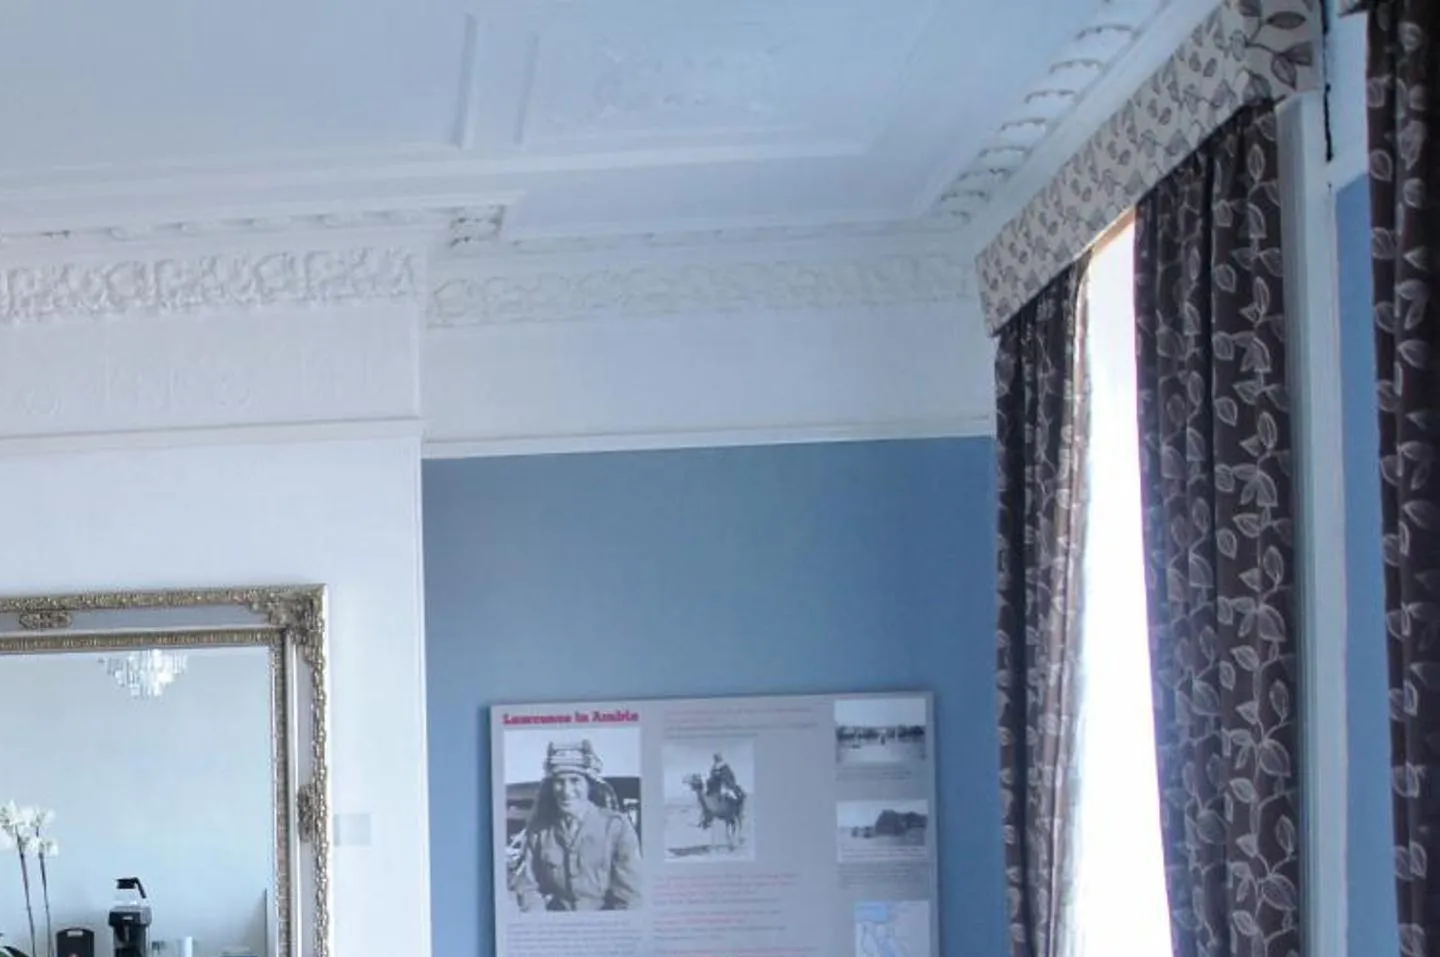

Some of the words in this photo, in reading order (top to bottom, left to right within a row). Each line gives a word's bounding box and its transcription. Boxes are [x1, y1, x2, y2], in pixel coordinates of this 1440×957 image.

[503, 712, 572, 725] Lawrence
[574, 710, 589, 723] in
[592, 710, 639, 722] Arabia
